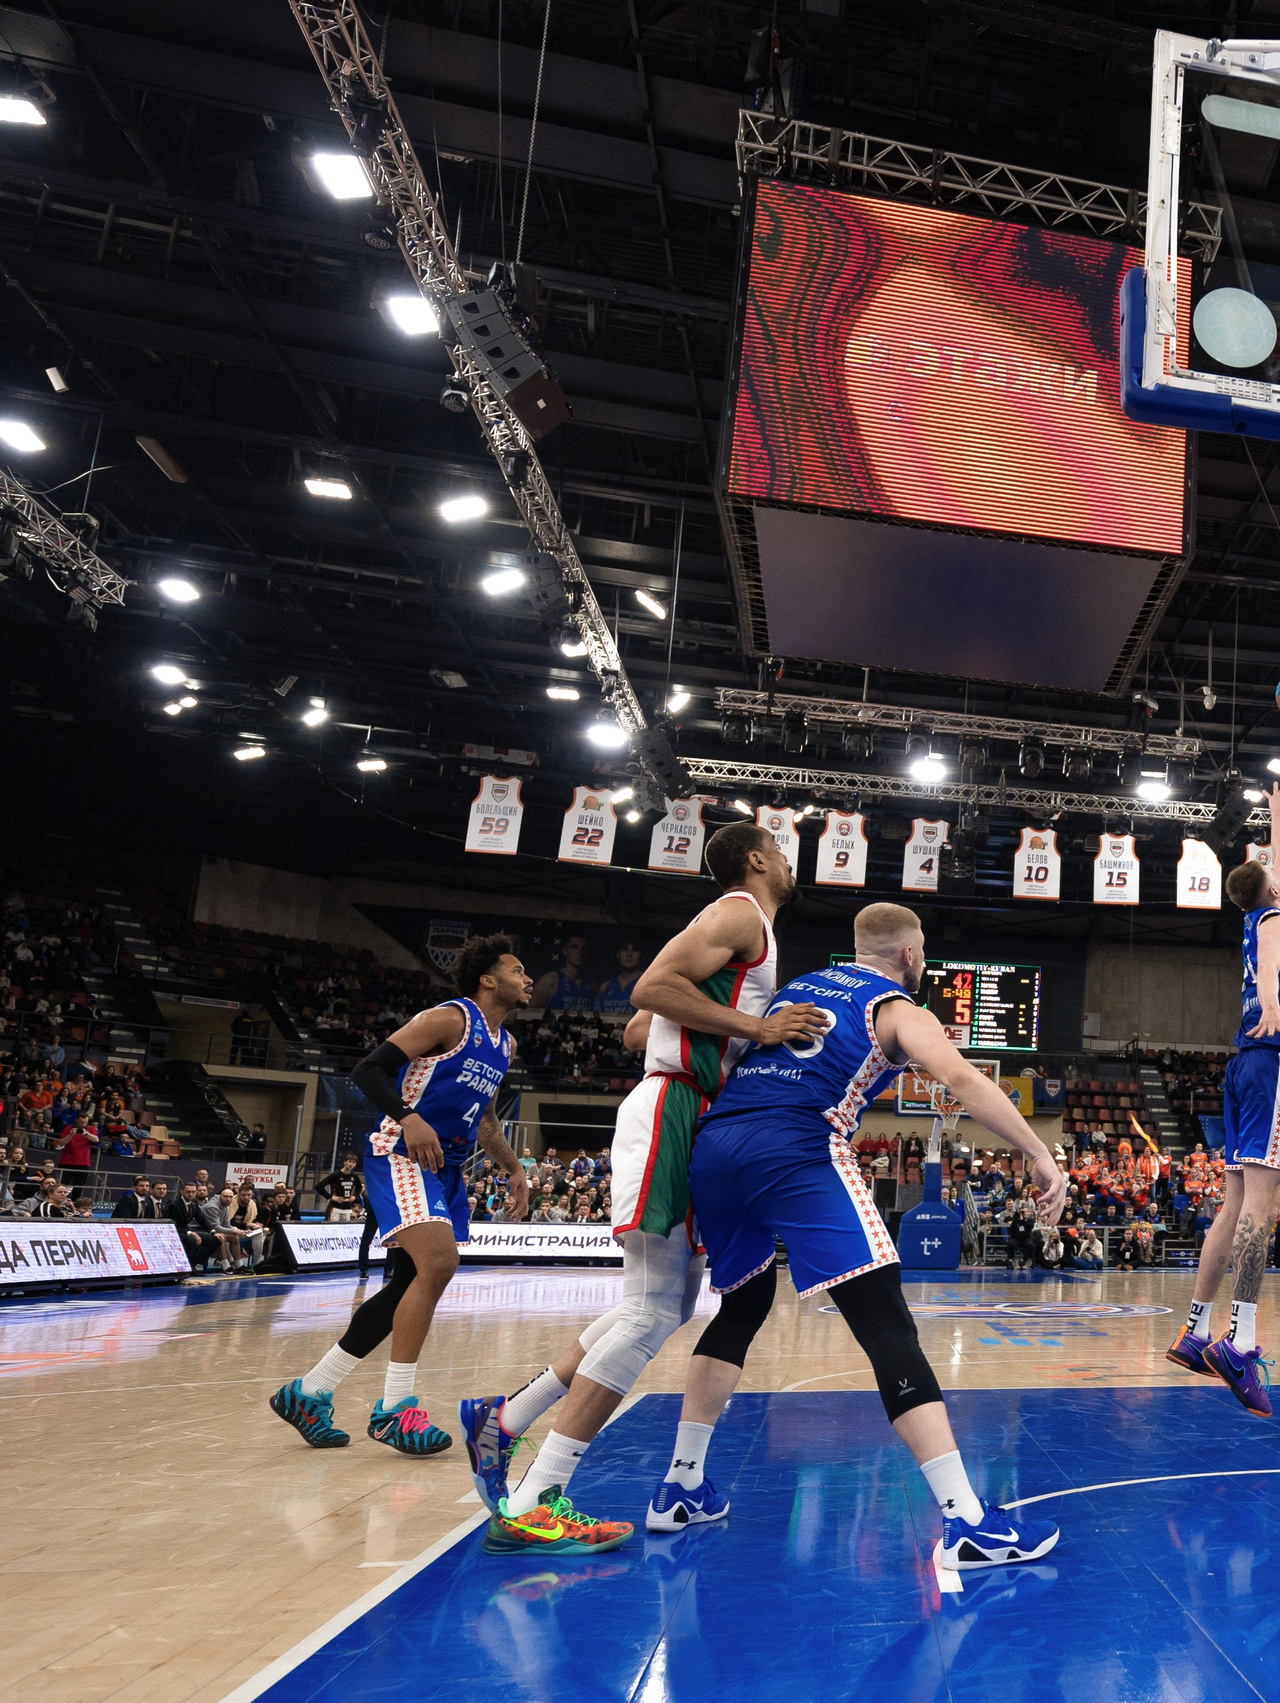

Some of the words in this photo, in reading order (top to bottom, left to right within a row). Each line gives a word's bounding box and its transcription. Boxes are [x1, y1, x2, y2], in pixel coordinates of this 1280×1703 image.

[476, 803, 518, 816] БОЛЕЛЬЩИК
[478, 816, 510, 835] 59
[577, 813, 603, 827] ШЕЙКО
[571, 827, 604, 846] 22
[661, 822, 697, 836] ЧЕРКАСОВ
[663, 835, 691, 854] 12
[832, 838, 855, 849] БЕЛЫХ
[834, 851, 850, 868] 9
[919, 857, 934, 874] 4
[1027, 853, 1048, 865] БЕЛОВ
[1099, 859, 1134, 869] БАШМИНОВ
[1023, 865, 1049, 883] 10
[1105, 871, 1128, 888] 15
[1188, 876, 1210, 893] 18
[952, 972, 972, 990] 42
[788, 981, 852, 1003] БЕТСИТИ
[943, 987, 972, 998] 5:49
[955, 998, 971, 1024] 5
[462, 1102, 480, 1128] 4
[233, 1166, 281, 1176] МЕДИЦИНСКАЯ
[253, 1175, 274, 1184] УЖБА
[297, 1237, 361, 1254] АДМИНИСТРАЦИЯ
[468, 1234, 611, 1249] МИНИСТРАЦИЯ
[29, 1239, 108, 1267] ПЕРМИ
